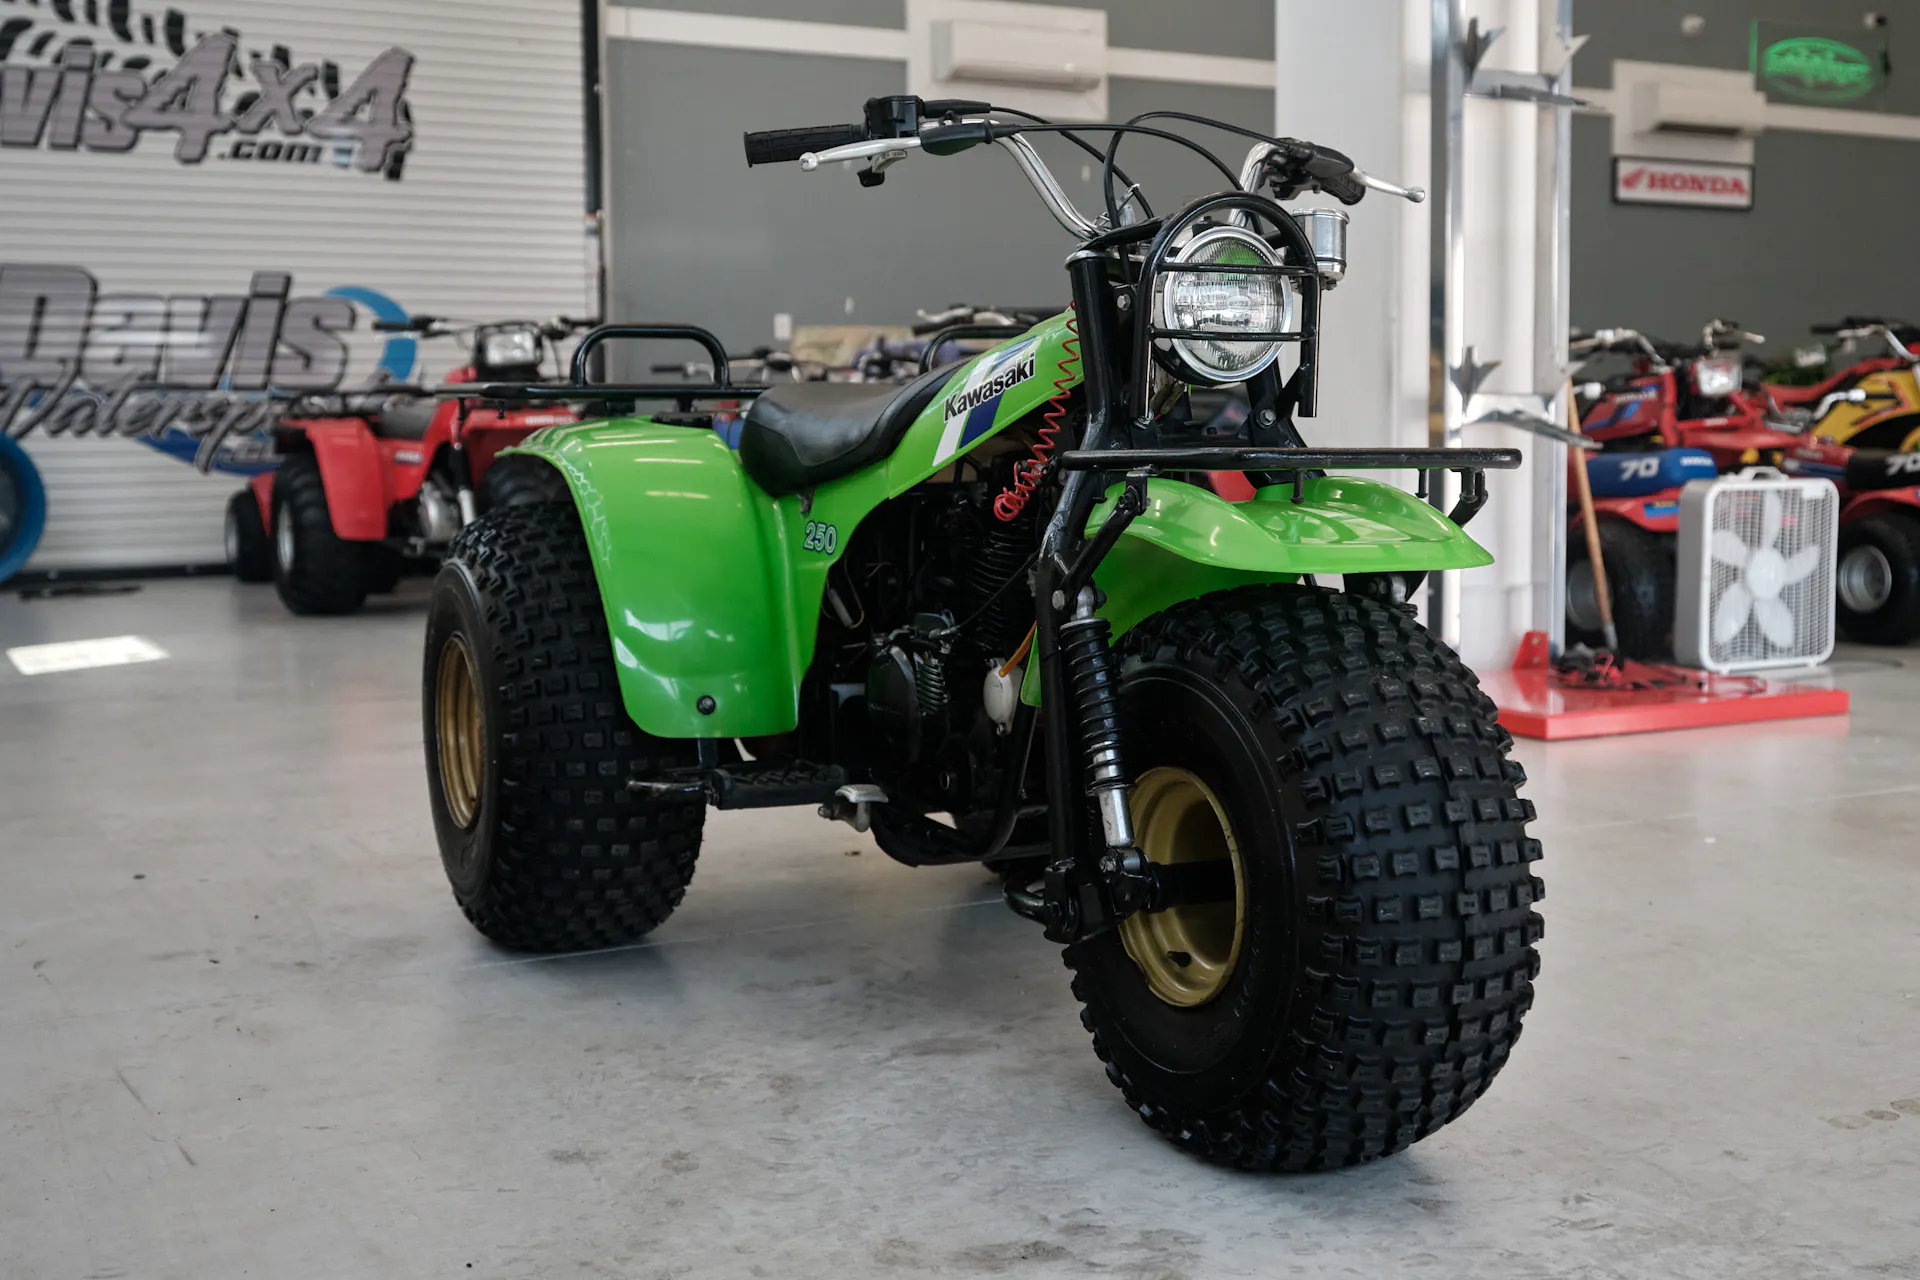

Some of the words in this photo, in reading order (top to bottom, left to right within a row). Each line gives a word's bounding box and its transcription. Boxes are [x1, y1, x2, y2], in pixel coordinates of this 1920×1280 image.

[1647, 171, 1748, 198] HONDA
[0, 263, 356, 390] Davis
[943, 352, 1037, 423] Kawasaki
[1619, 456, 1660, 481] 70
[803, 520, 838, 555] 250
